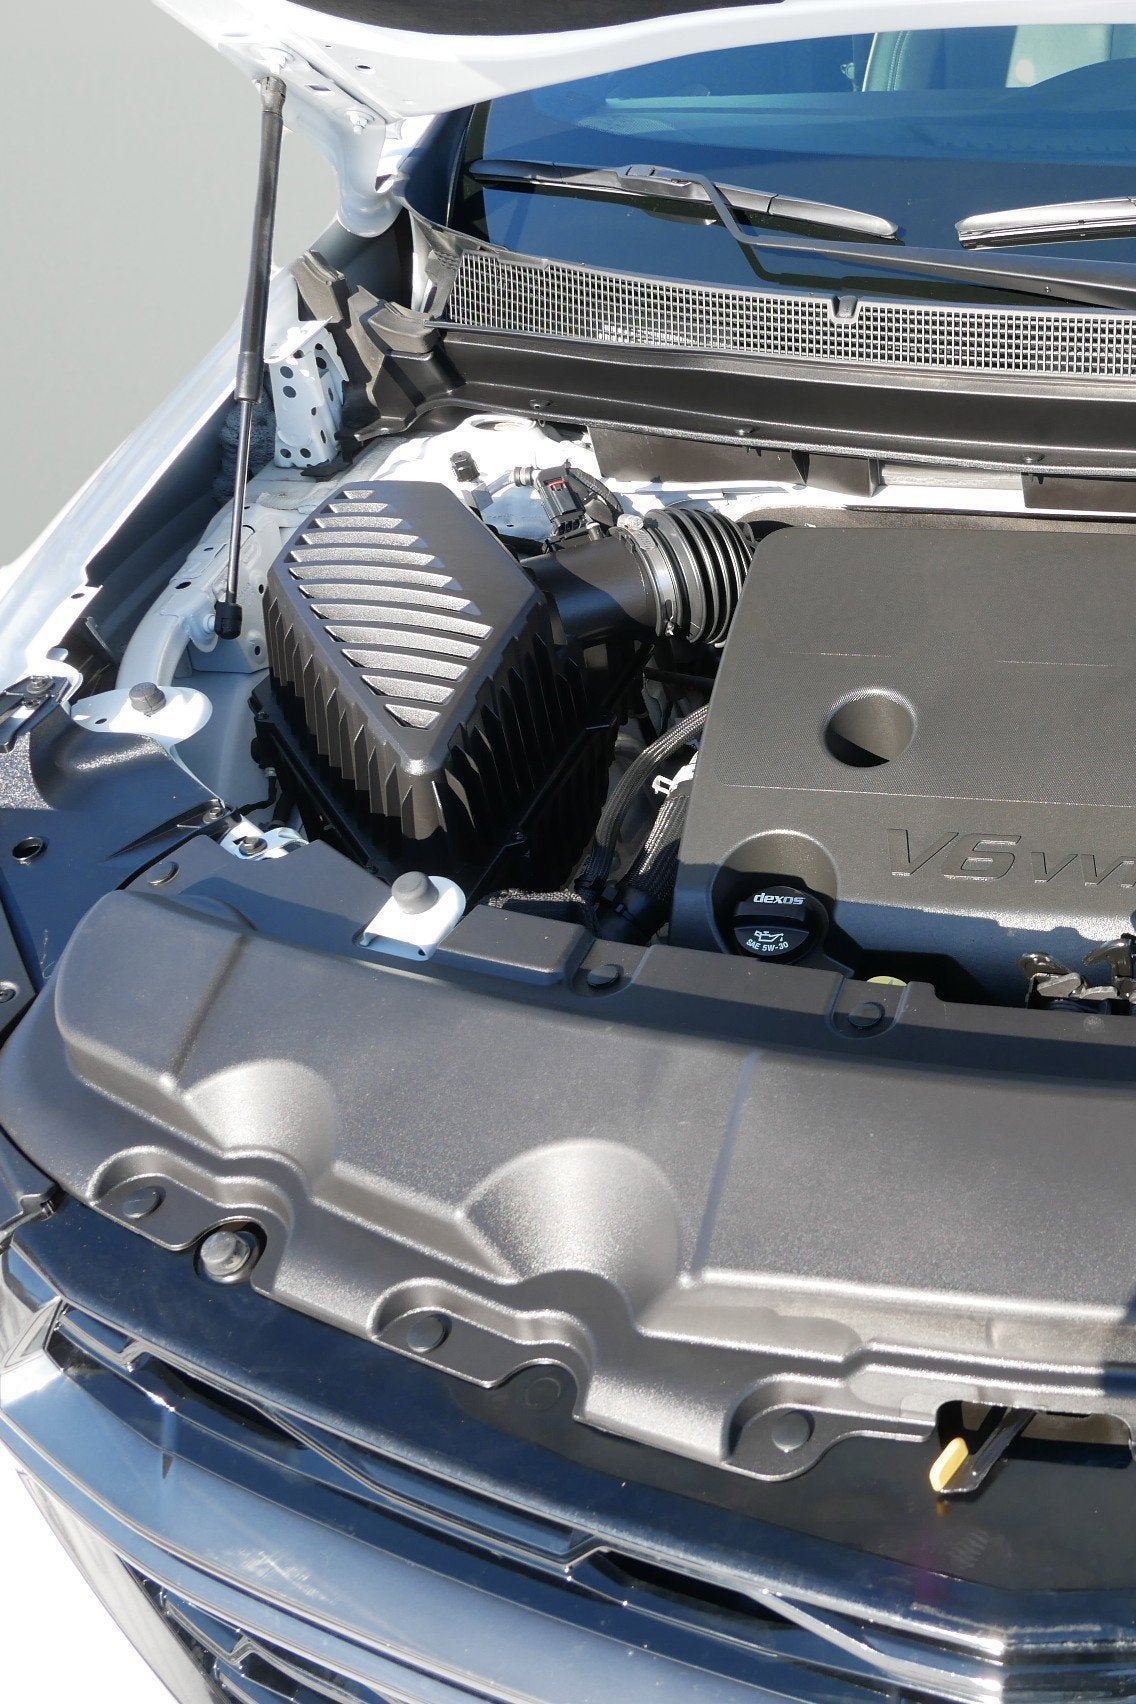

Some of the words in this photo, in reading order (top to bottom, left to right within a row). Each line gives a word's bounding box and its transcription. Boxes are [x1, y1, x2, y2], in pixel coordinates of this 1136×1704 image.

[887, 828, 1022, 881] V6
[753, 892, 806, 905] dexos
[746, 938, 761, 950] SAE
[762, 941, 789, 951] 5W-30
